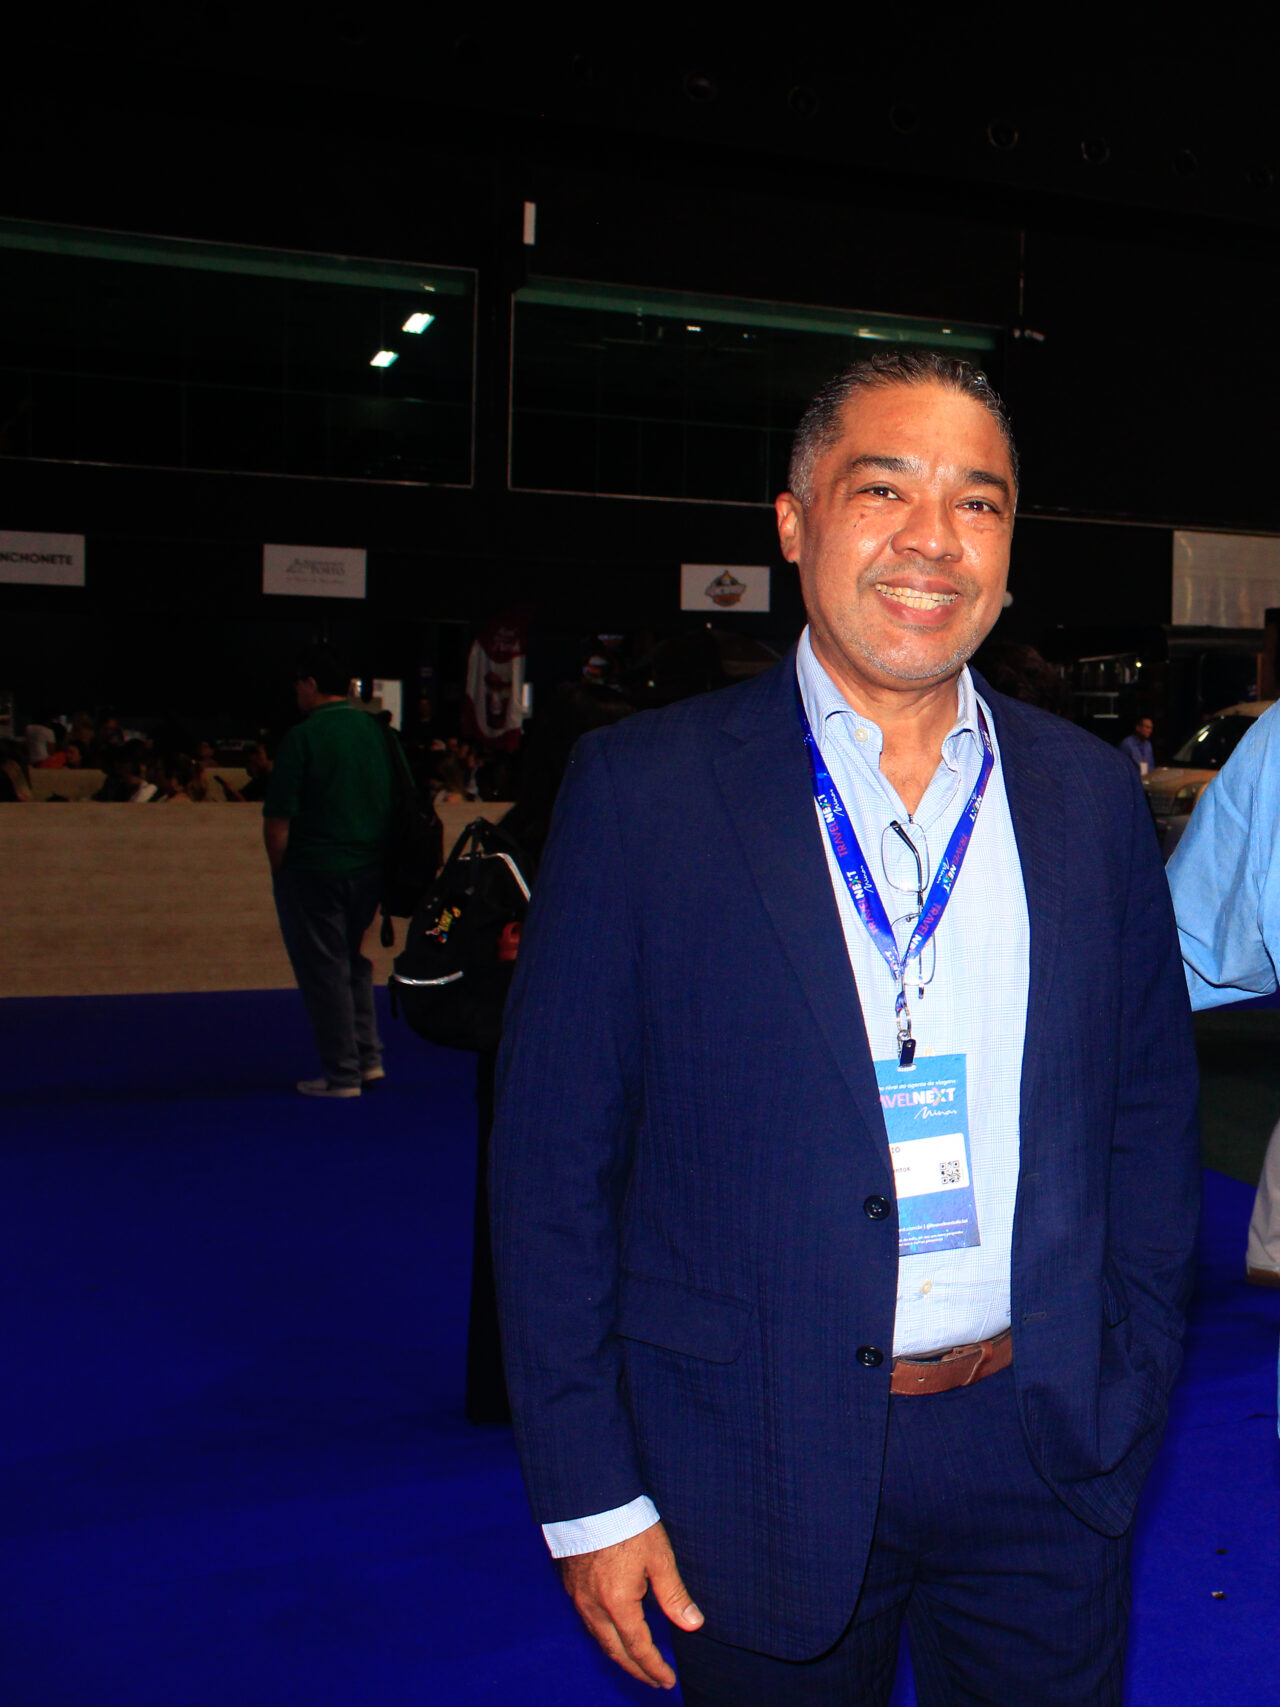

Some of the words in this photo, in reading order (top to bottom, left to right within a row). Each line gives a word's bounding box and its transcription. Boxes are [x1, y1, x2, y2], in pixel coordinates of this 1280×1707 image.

[817, 793, 849, 858] TRAVELNEXT
[942, 833, 969, 895] TRAVELNEXT
[846, 870, 879, 934] TRAVELNEXT
